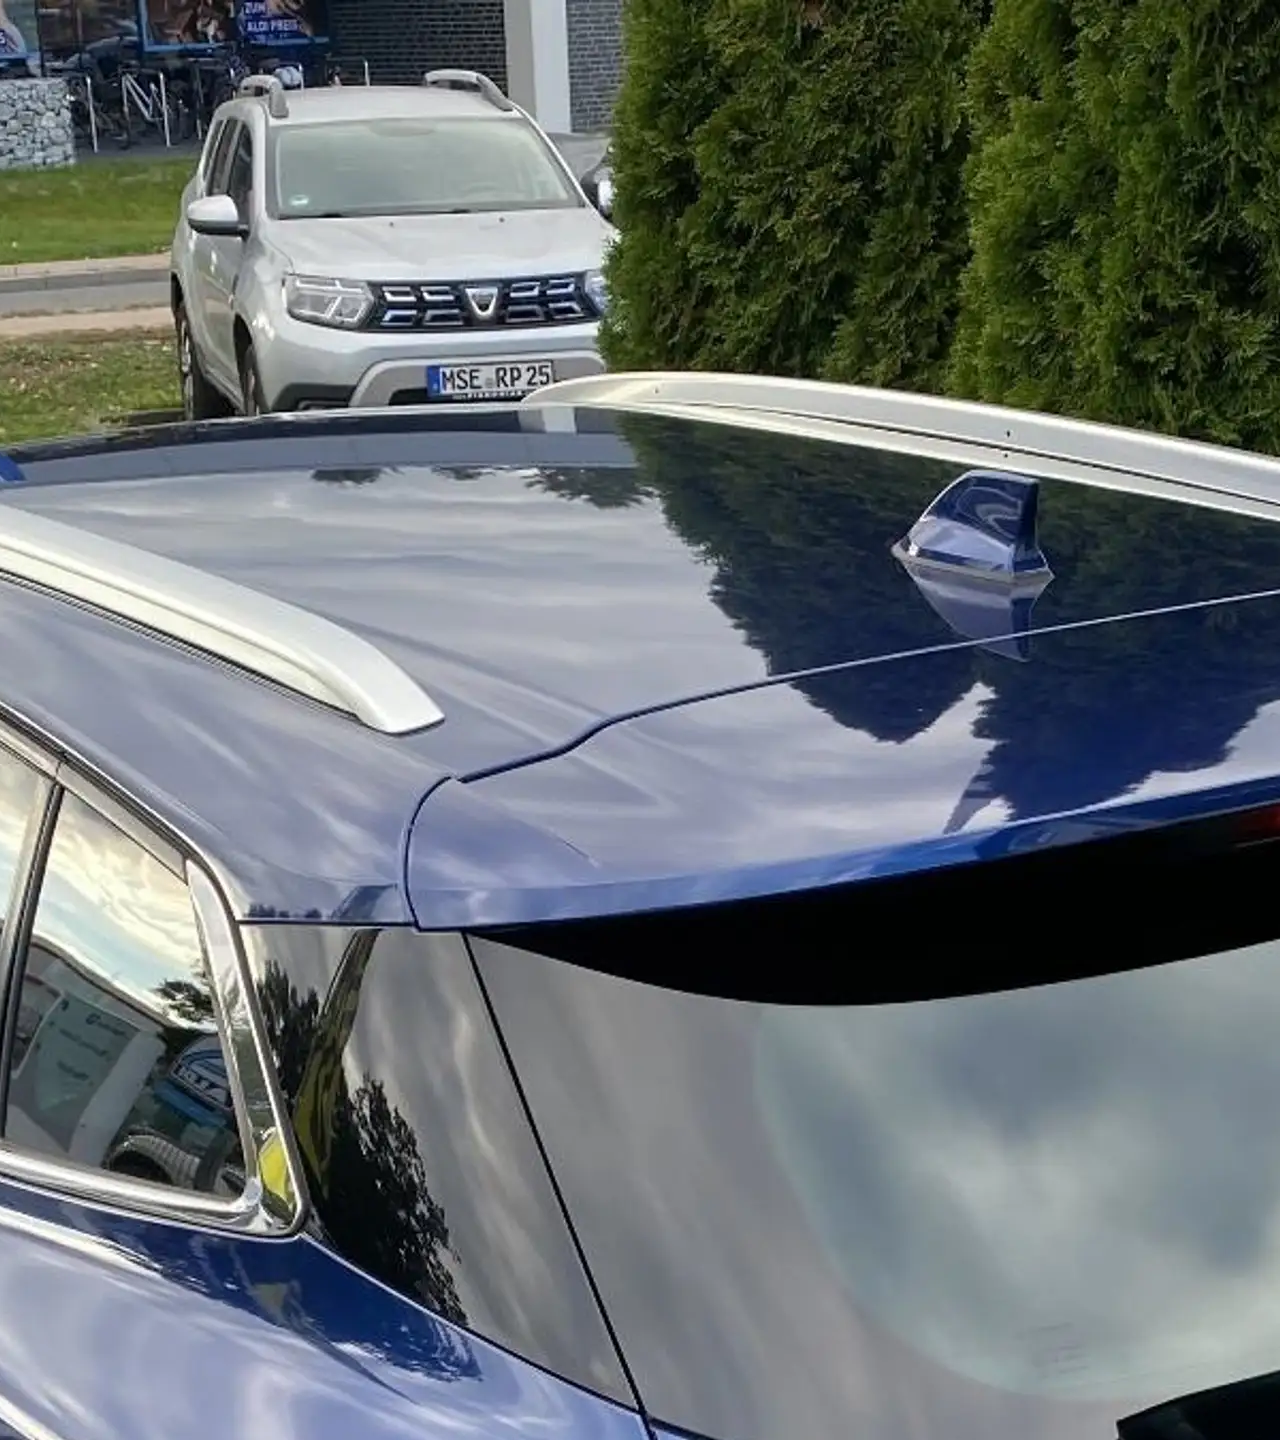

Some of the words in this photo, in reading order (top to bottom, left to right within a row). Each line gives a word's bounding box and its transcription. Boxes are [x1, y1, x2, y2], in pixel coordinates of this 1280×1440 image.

[441, 368, 482, 391] MSE
[495, 366, 522, 388] RP
[526, 364, 550, 386] 25
